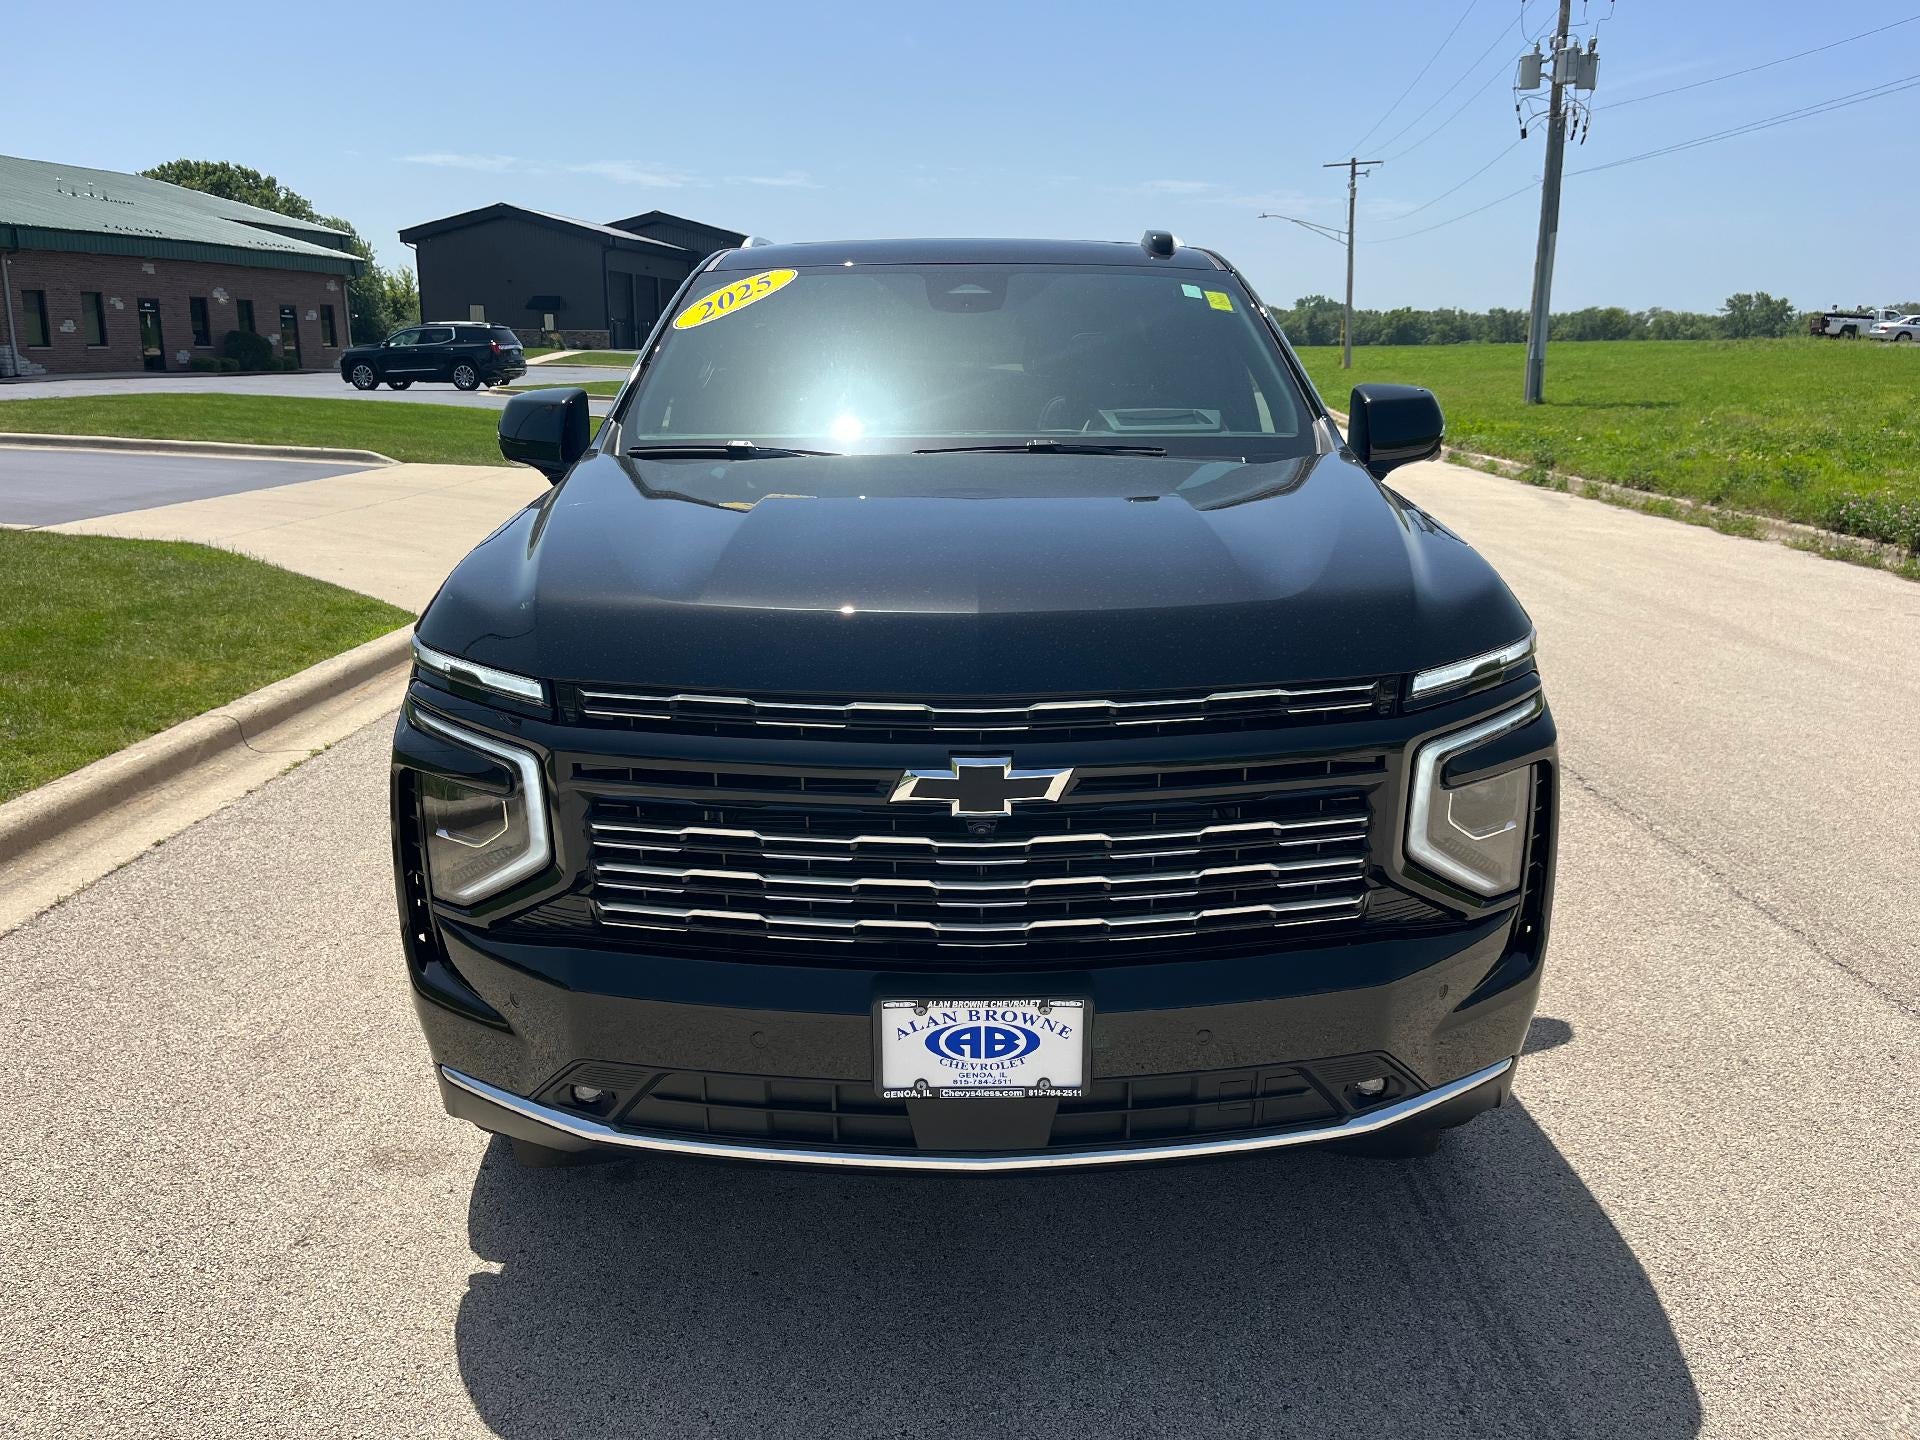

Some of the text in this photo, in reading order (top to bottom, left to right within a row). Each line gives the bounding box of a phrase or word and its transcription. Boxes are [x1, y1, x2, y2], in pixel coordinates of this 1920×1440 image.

[699, 275, 771, 320] 2025
[926, 1000, 1042, 1009] ALAN BROWNE CHEVROLET
[896, 1009, 1073, 1041] ALAN BROWNE
[939, 1056, 1026, 1071] CHEVROLET
[883, 1090, 921, 1099] GENOA,
[922, 1089, 933, 1097] IL
[941, 1089, 1023, 1098] Chevys4less.com
